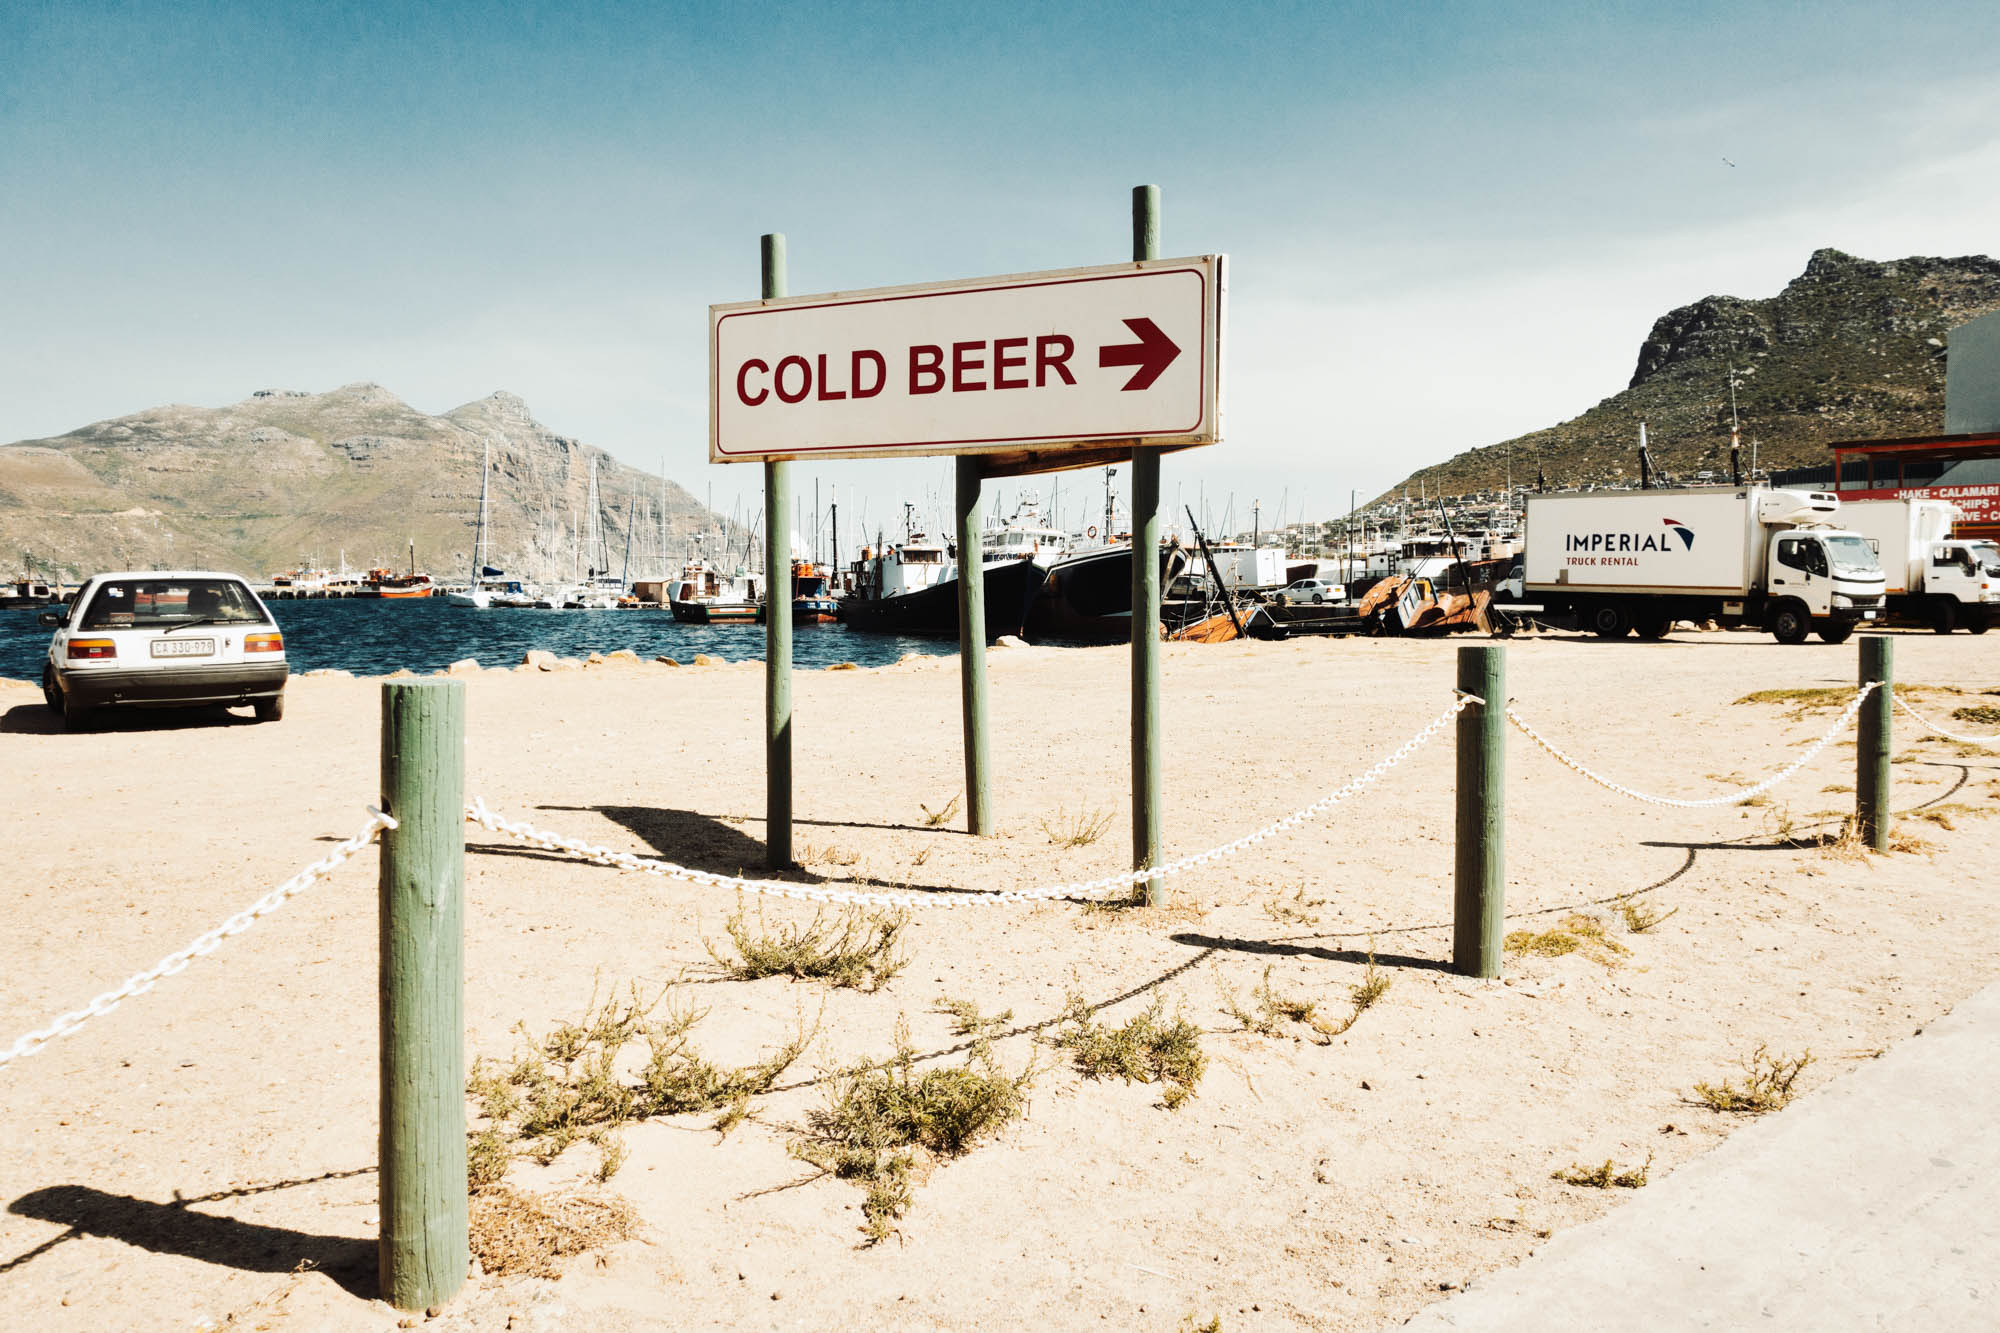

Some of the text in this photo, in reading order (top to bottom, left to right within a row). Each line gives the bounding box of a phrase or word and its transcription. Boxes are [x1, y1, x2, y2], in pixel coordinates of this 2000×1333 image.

[736, 334, 1077, 407] COLD BEER
[1899, 486, 1999, 499] HAKE CALAMARI
[1566, 533, 1672, 552] IMPERIAL
[1566, 557, 1639, 566] TRUCK RENTAL
[155, 643, 169, 654] CA
